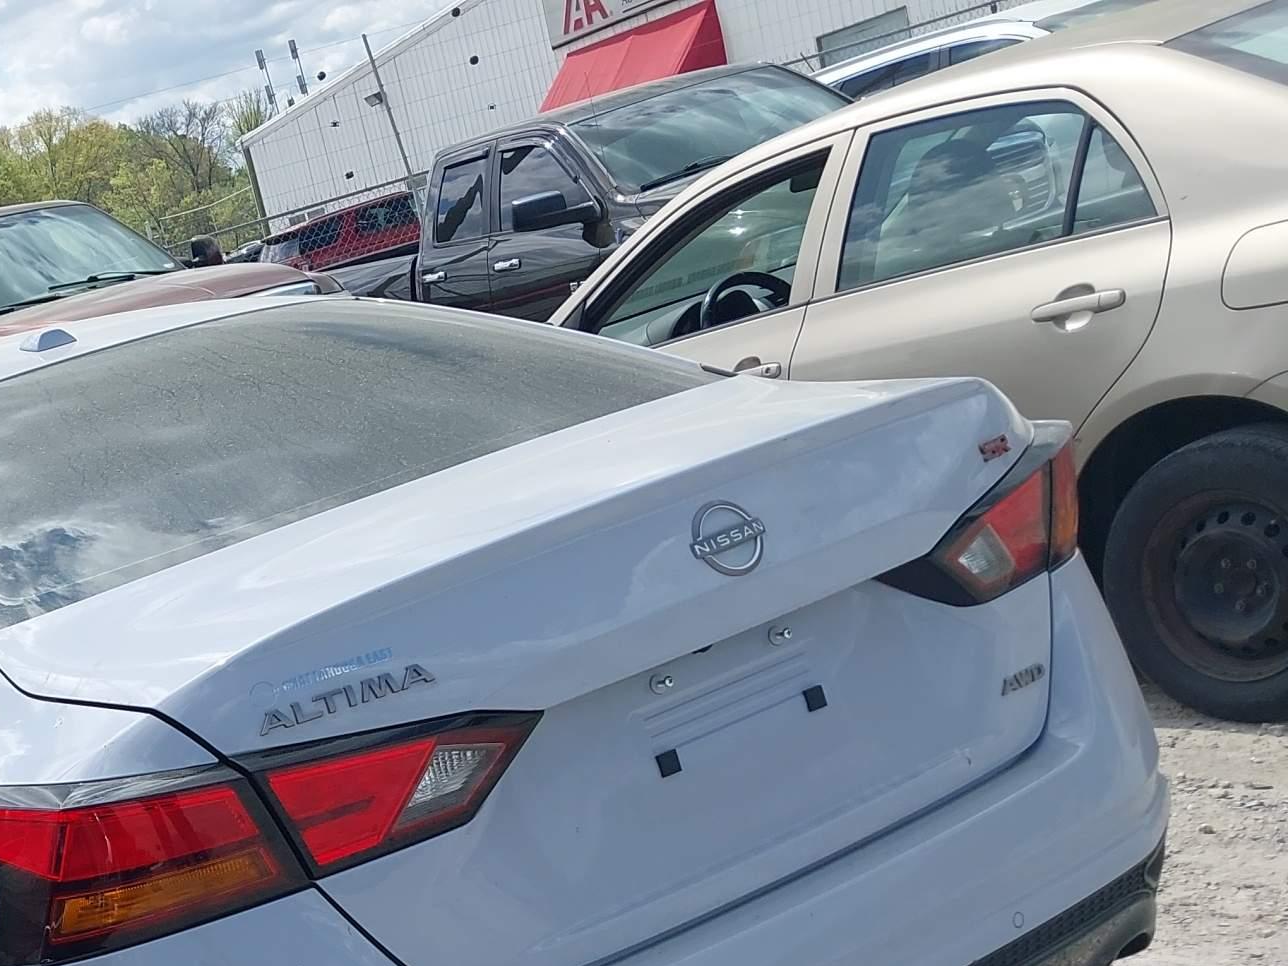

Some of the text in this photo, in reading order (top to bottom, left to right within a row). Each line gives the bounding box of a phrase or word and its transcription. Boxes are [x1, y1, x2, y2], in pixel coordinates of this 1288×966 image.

[693, 520, 764, 556] NISSAN
[1001, 663, 1046, 696] AWD
[259, 663, 436, 737] ALTIMA
